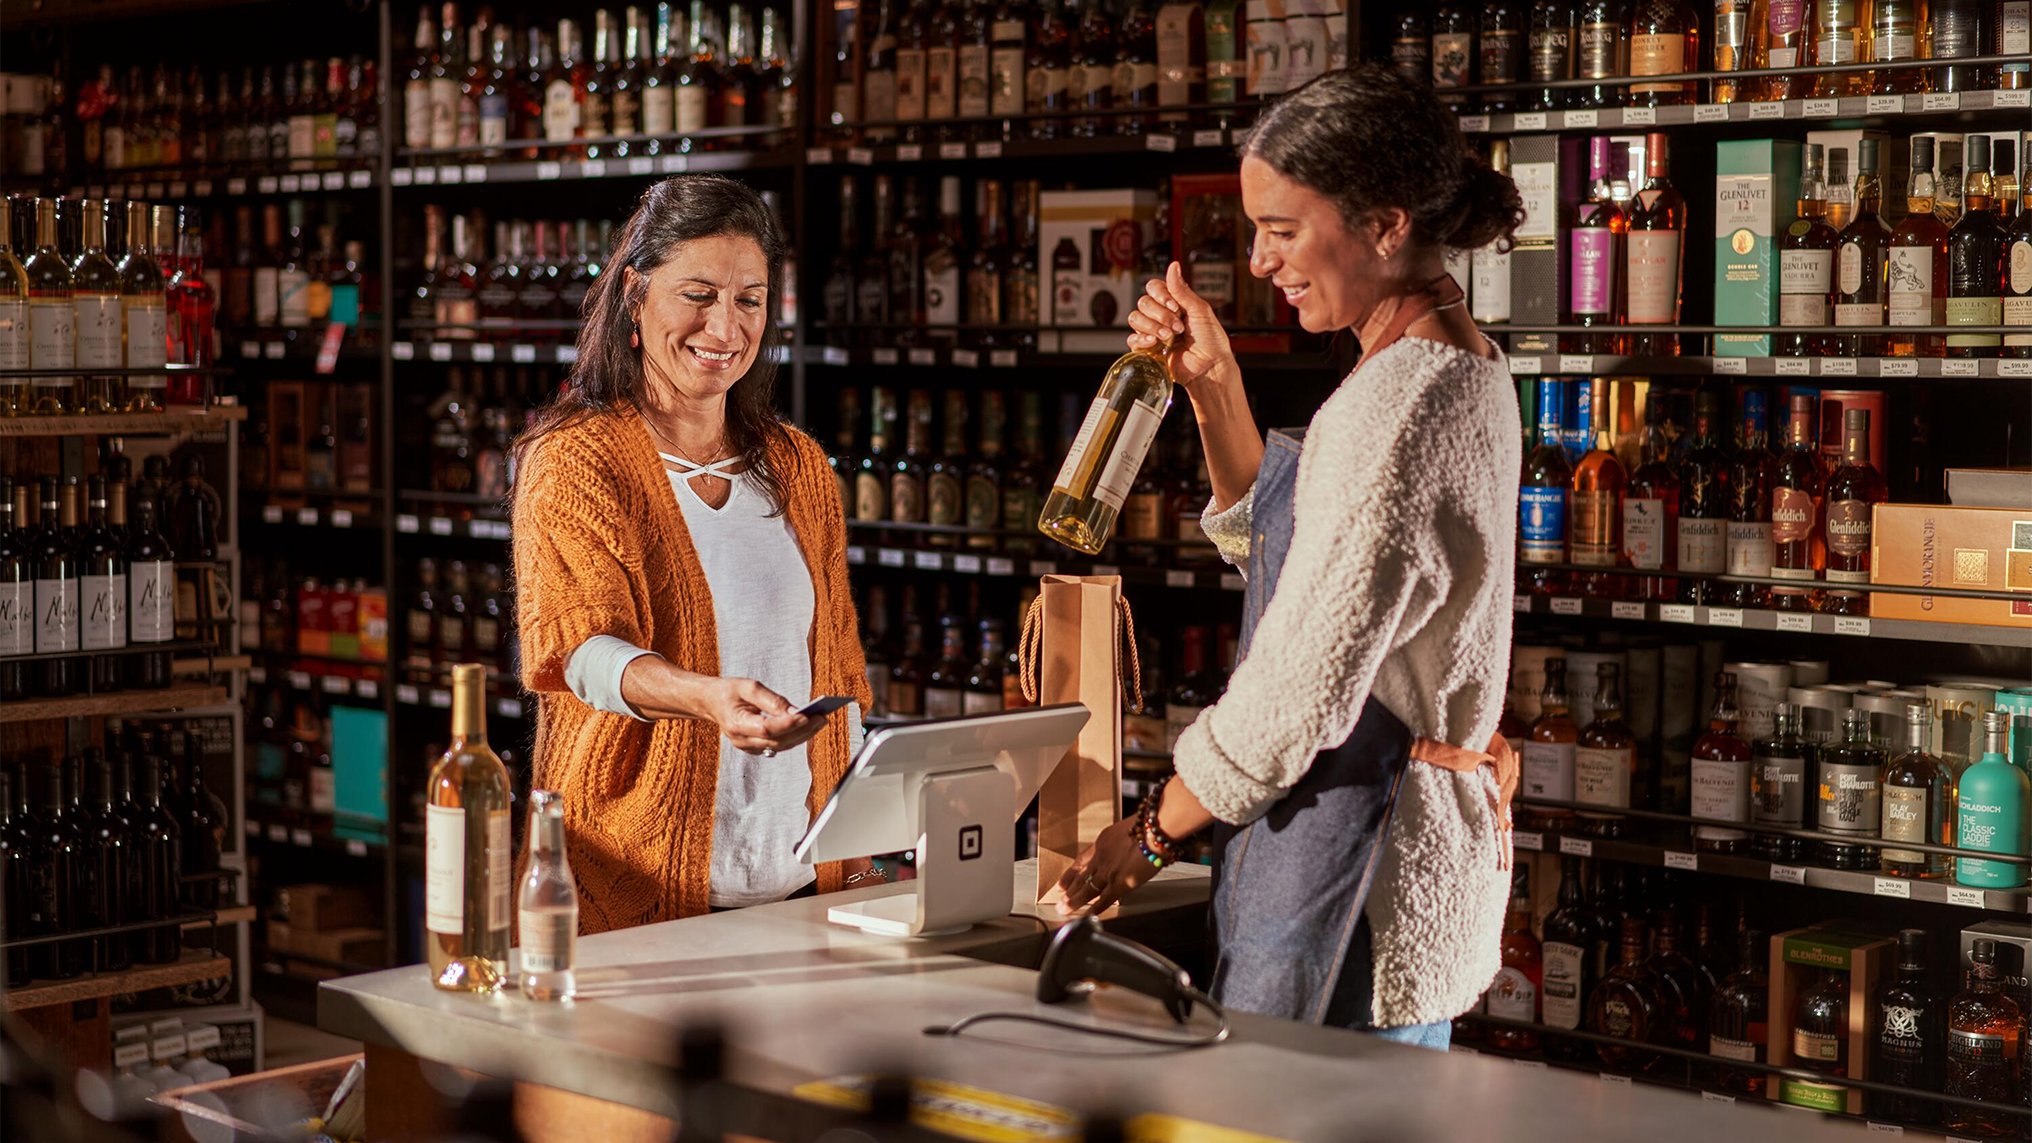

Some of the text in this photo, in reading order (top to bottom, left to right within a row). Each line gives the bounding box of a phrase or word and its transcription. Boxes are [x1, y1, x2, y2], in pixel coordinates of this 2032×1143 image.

[1777, 15, 1787, 25] 15
[1720, 189, 1767, 201] GLENLIVET
[1528, 201, 1538, 211] 12
[1737, 200, 1749, 211] 12
[1773, 509, 1807, 523] enfiddich
[1728, 528, 1765, 541] enfiddich
[1920, 517, 1935, 611] GLNMORANGIE
[1840, 773, 1858, 782] PORT
[1840, 780, 1875, 790] CHARLOTTE
[1889, 803, 1910, 811] ISLAY
[1889, 810, 1918, 820] BARLEY
[1963, 815, 1976, 825] THE
[1962, 824, 1996, 835] CLASSIC
[1962, 832, 1991, 844] LADDIE
[1790, 949, 1844, 965] GLENROTHES
[1881, 1035, 1923, 1048] MAGNUS
[1951, 1034, 2001, 1049] HIGHLAND
